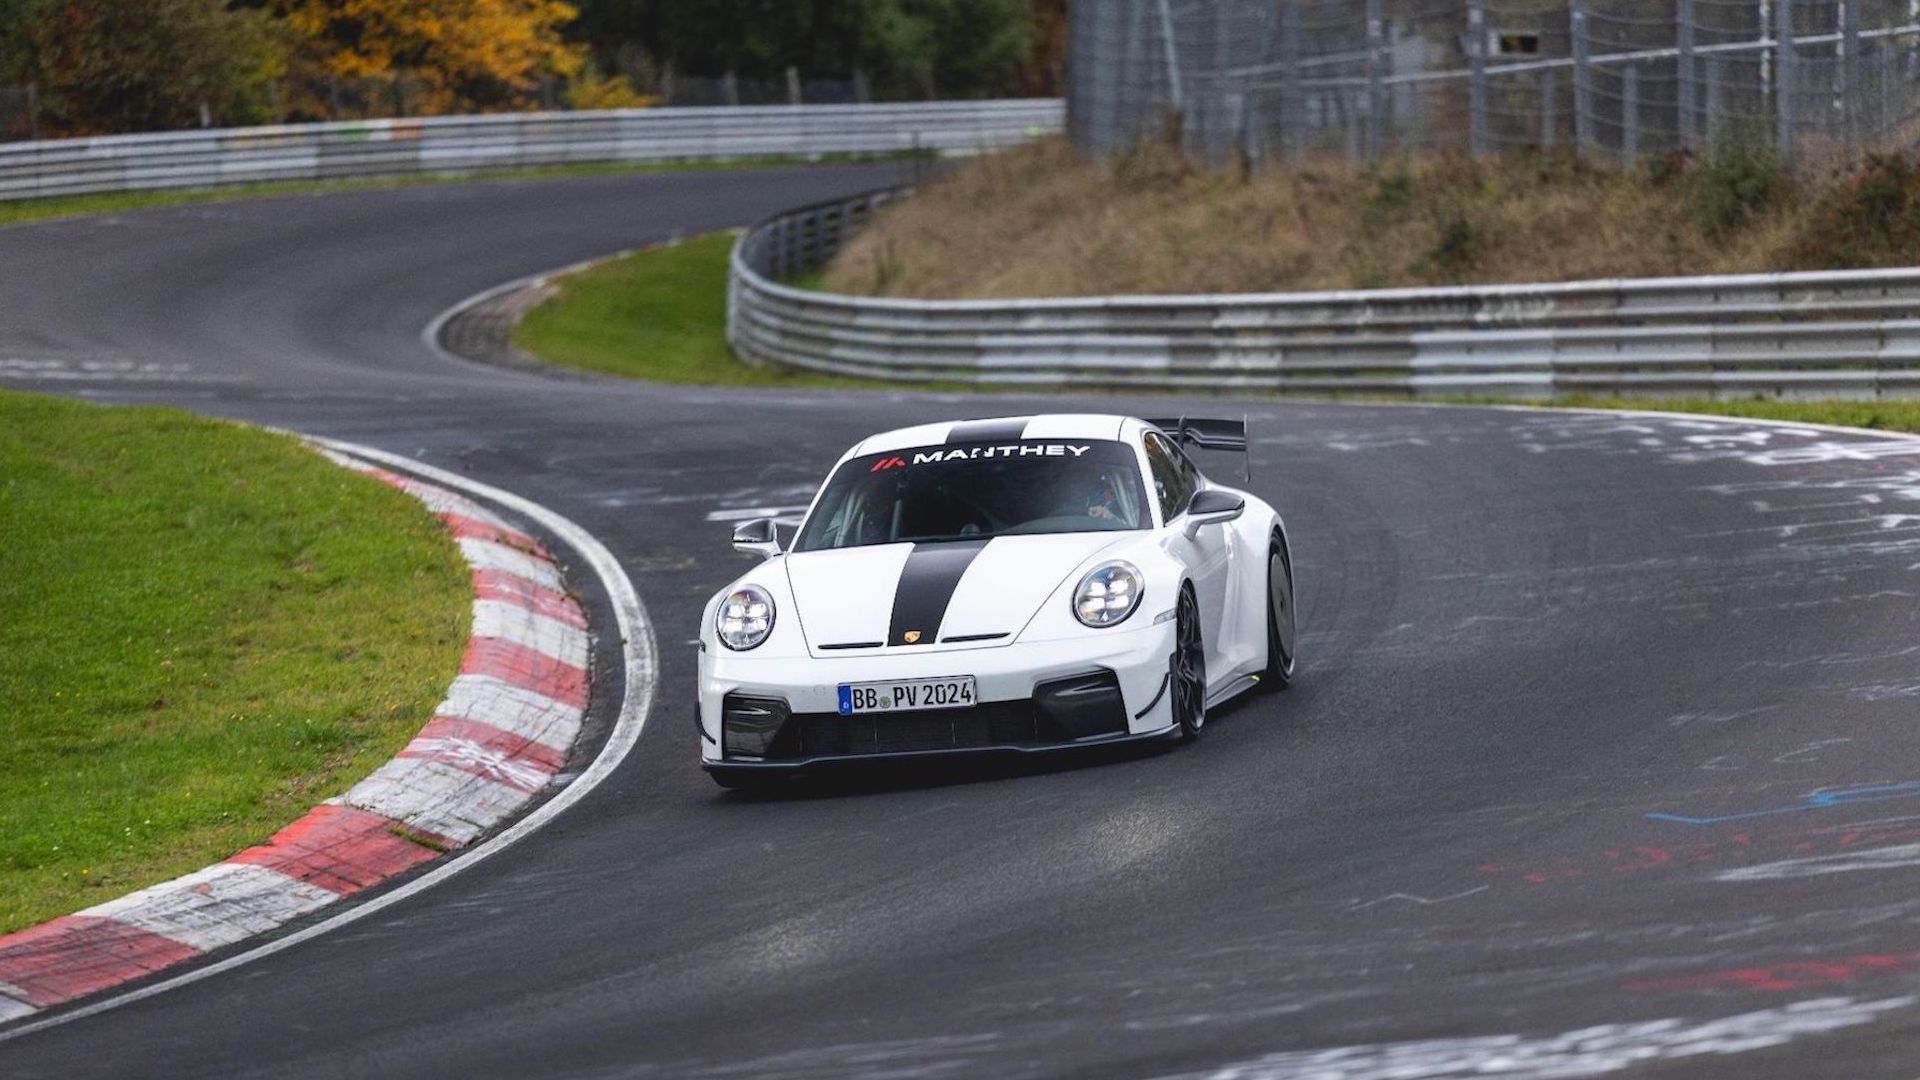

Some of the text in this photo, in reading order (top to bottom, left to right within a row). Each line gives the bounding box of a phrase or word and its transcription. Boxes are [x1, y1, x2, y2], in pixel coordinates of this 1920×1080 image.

[913, 445, 1090, 465] MANTHEY
[853, 682, 971, 709] BB PV 2024
